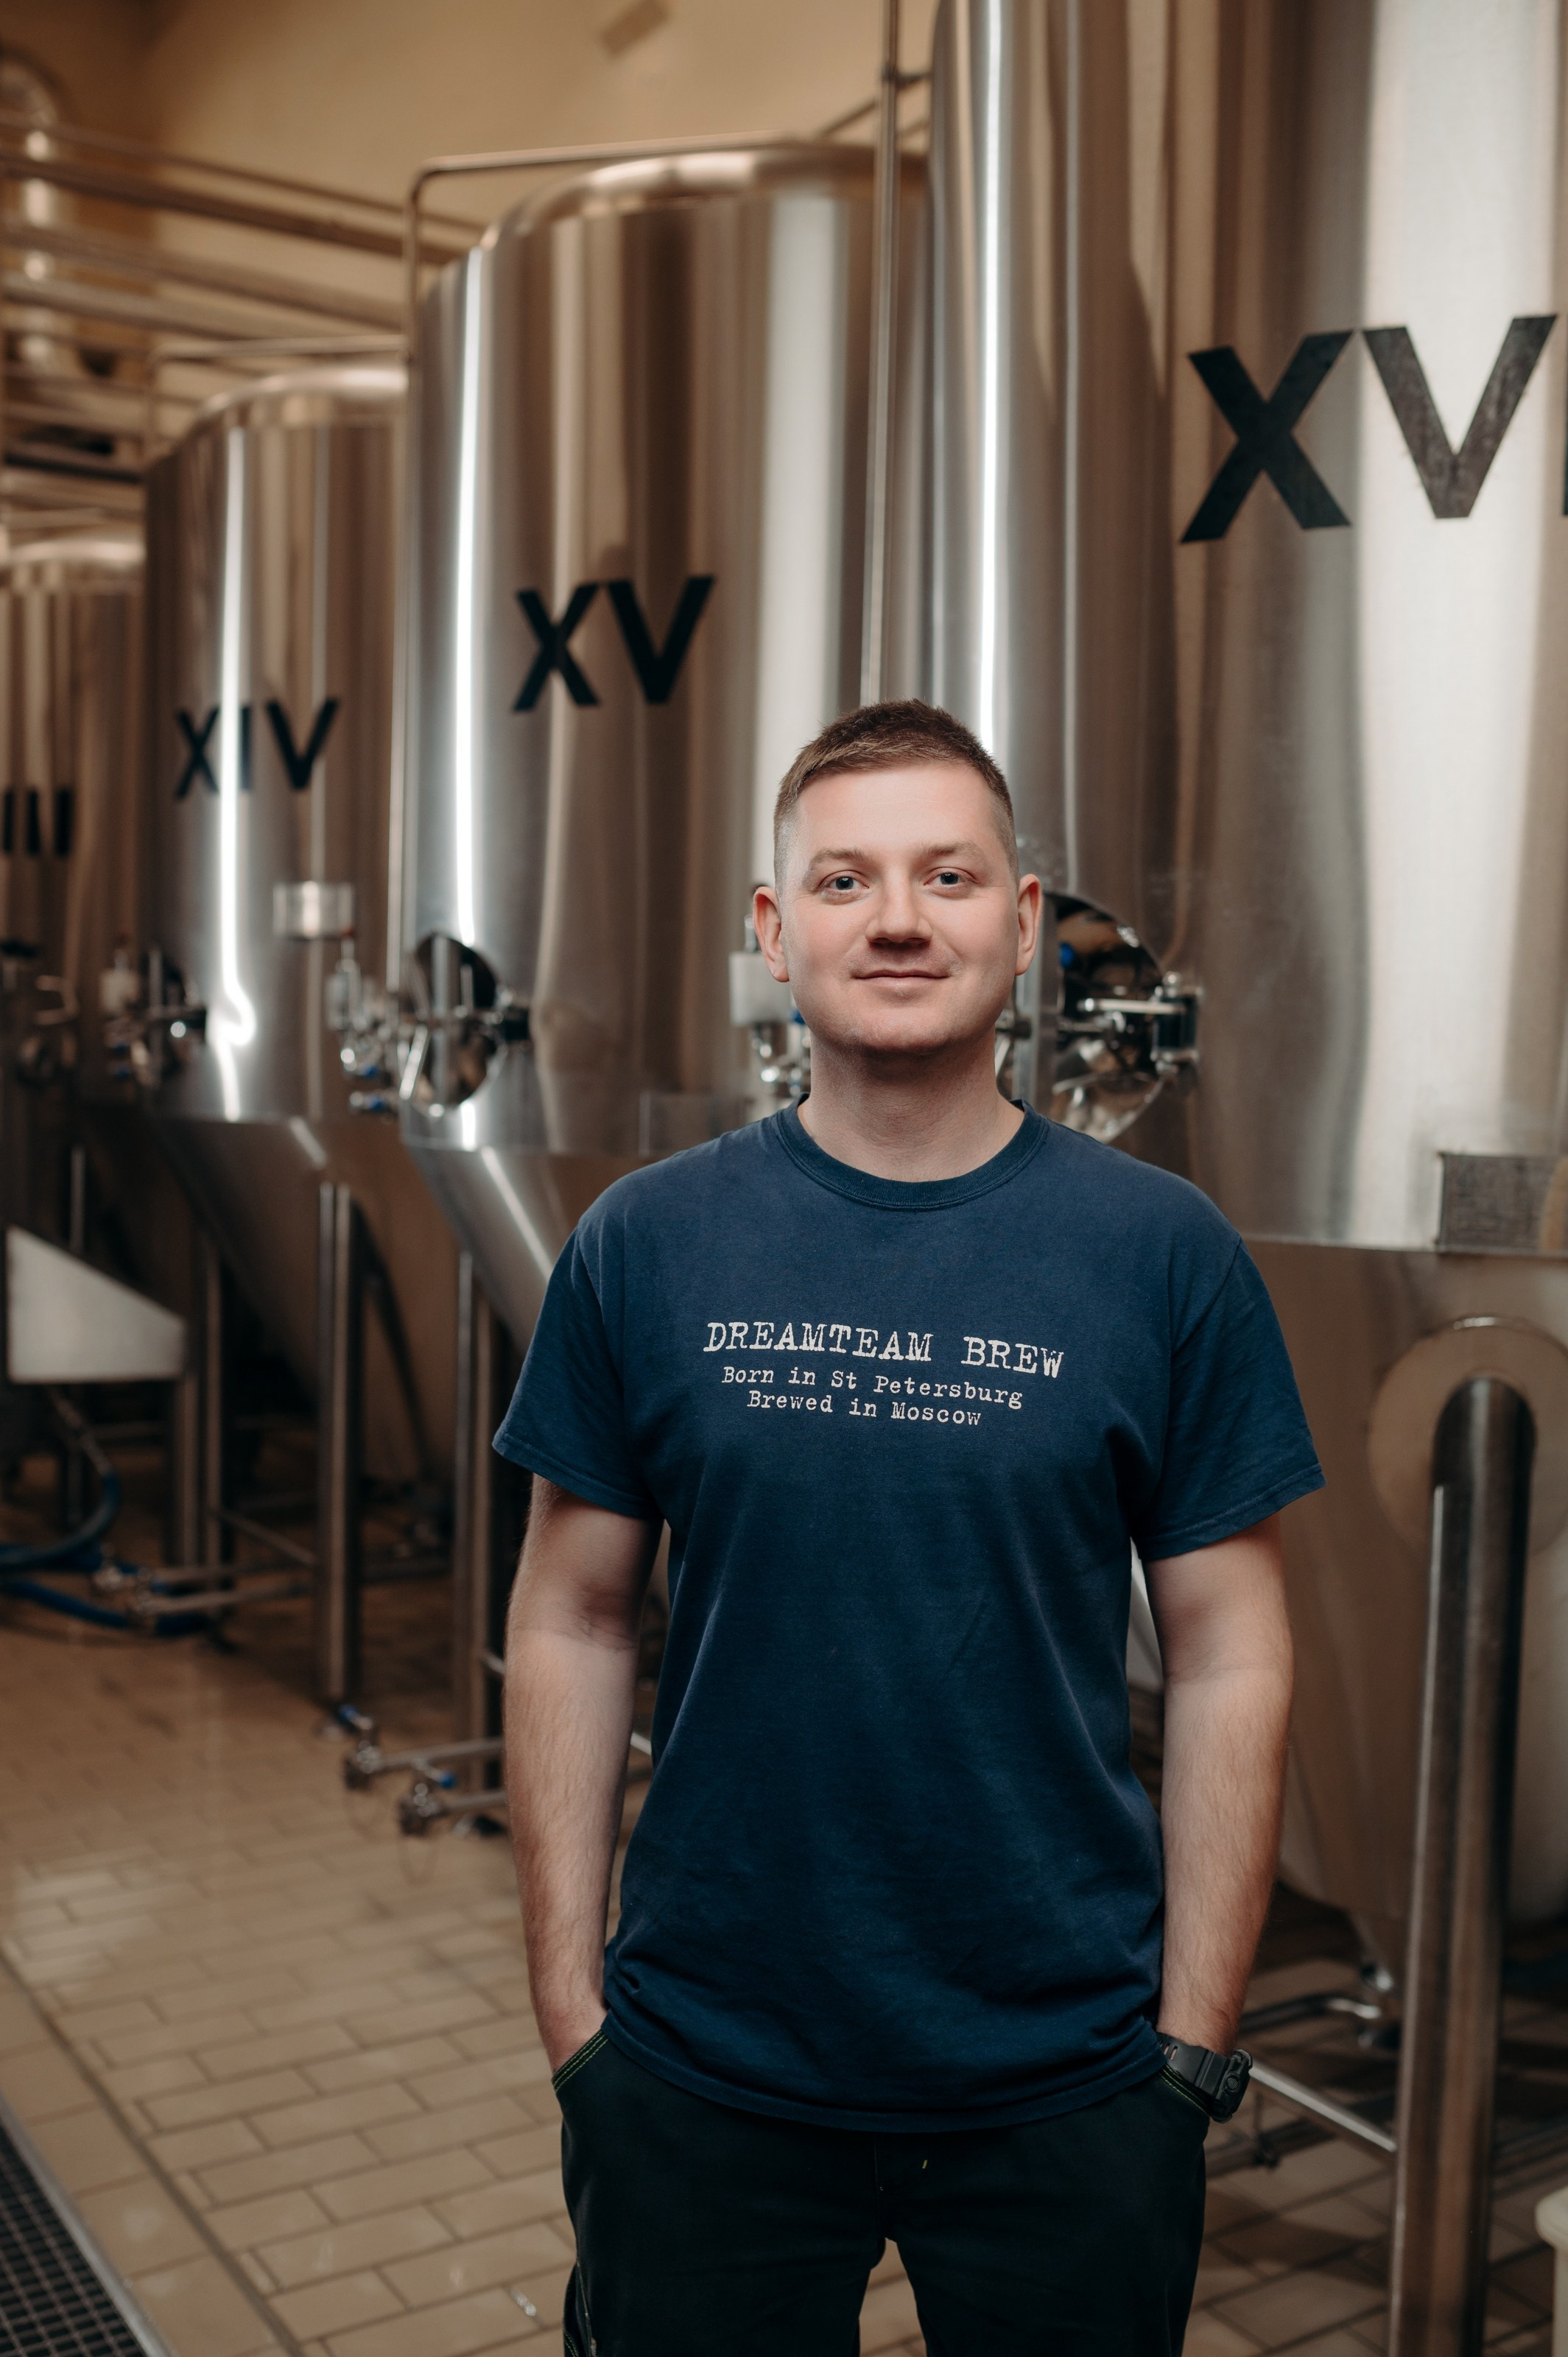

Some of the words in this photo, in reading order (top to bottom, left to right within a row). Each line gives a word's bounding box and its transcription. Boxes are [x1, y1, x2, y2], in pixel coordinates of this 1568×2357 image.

[1180, 313, 1568, 544] XV
[513, 574, 715, 713] XV
[174, 698, 339, 801] XIV
[703, 1321, 934, 1362] DREAMTEAM
[960, 1336, 1064, 1379] BREW
[721, 1366, 774, 1383] Born
[788, 1366, 816, 1385] in
[831, 1370, 857, 1390] St
[873, 1375, 1023, 1410] Petersburg
[746, 1390, 833, 1413] Brewed
[848, 1397, 877, 1418] in
[890, 1401, 982, 1426] Moscow
